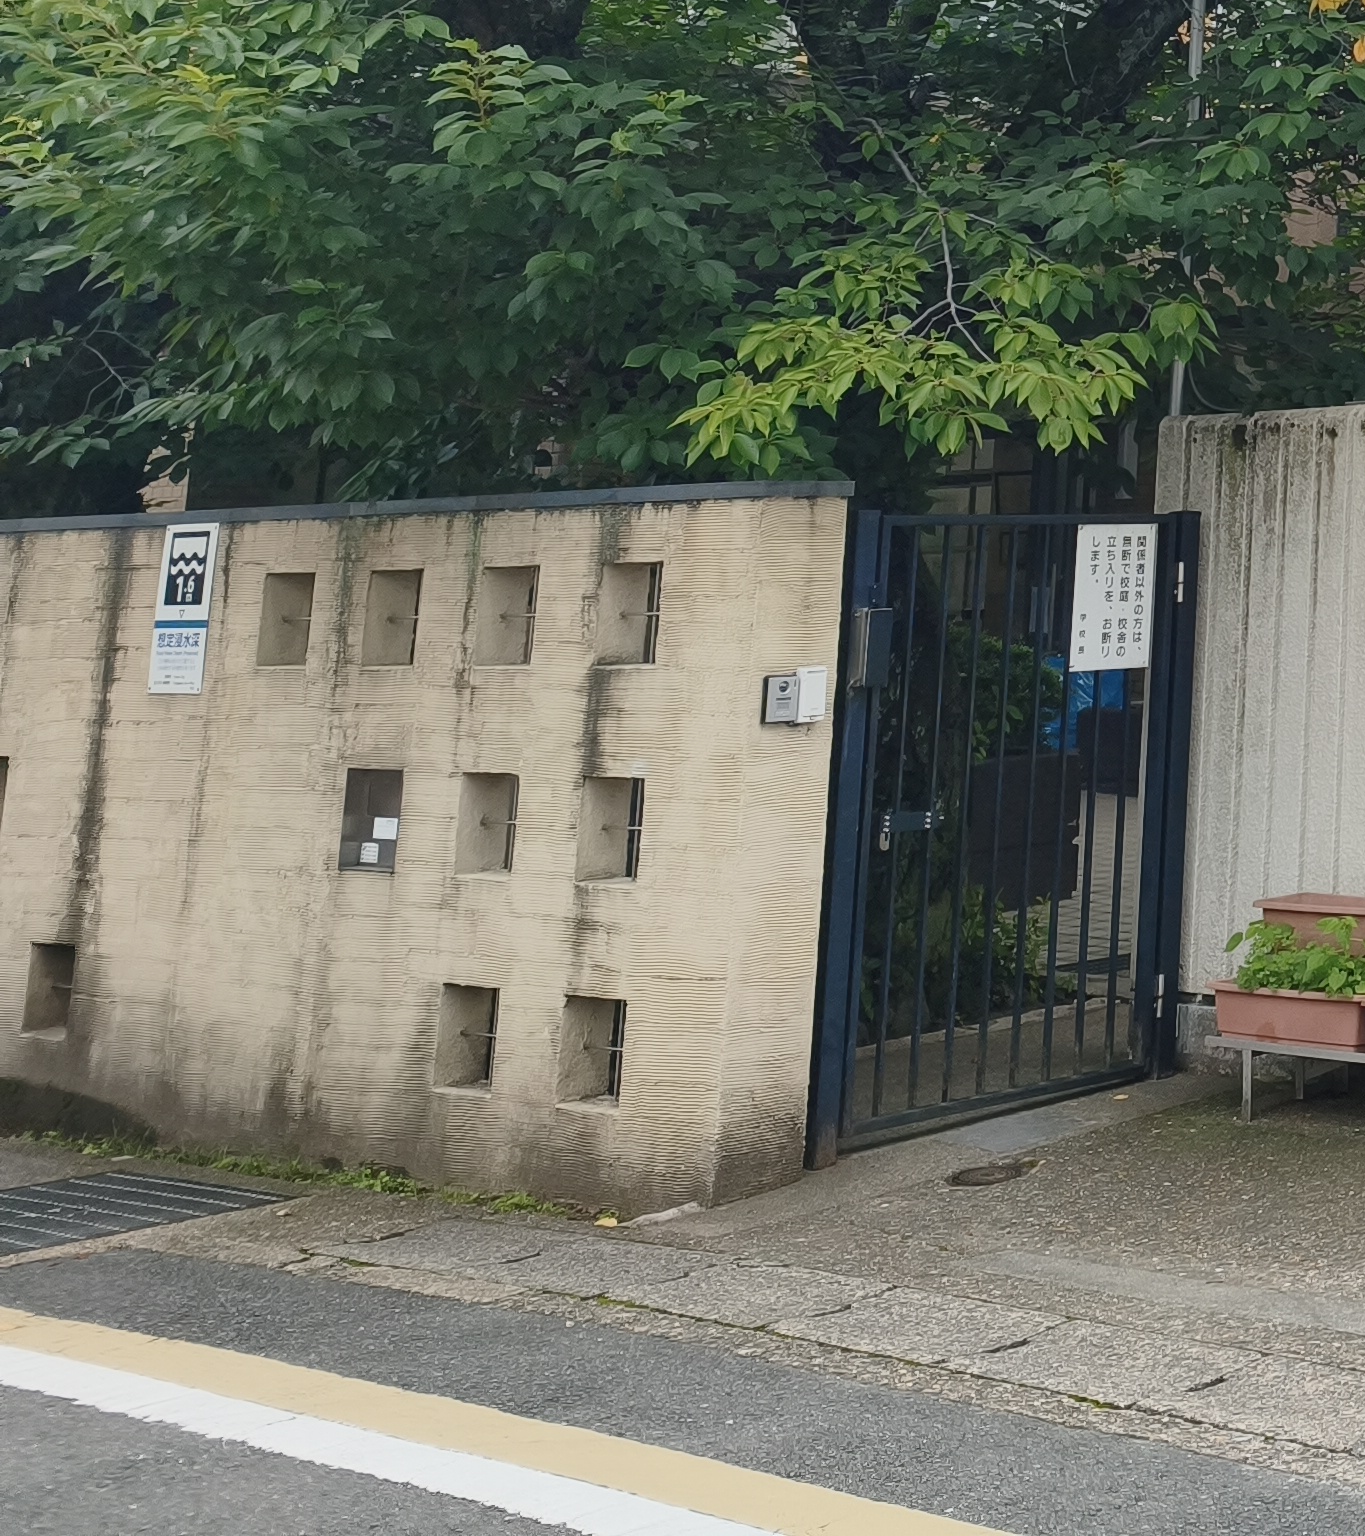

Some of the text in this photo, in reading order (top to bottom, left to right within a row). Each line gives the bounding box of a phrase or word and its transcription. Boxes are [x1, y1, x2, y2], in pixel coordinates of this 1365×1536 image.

[1101, 536, 1116, 658] 立ち入りを、お断り
[1132, 536, 1147, 651] 関係者以外の方は、
